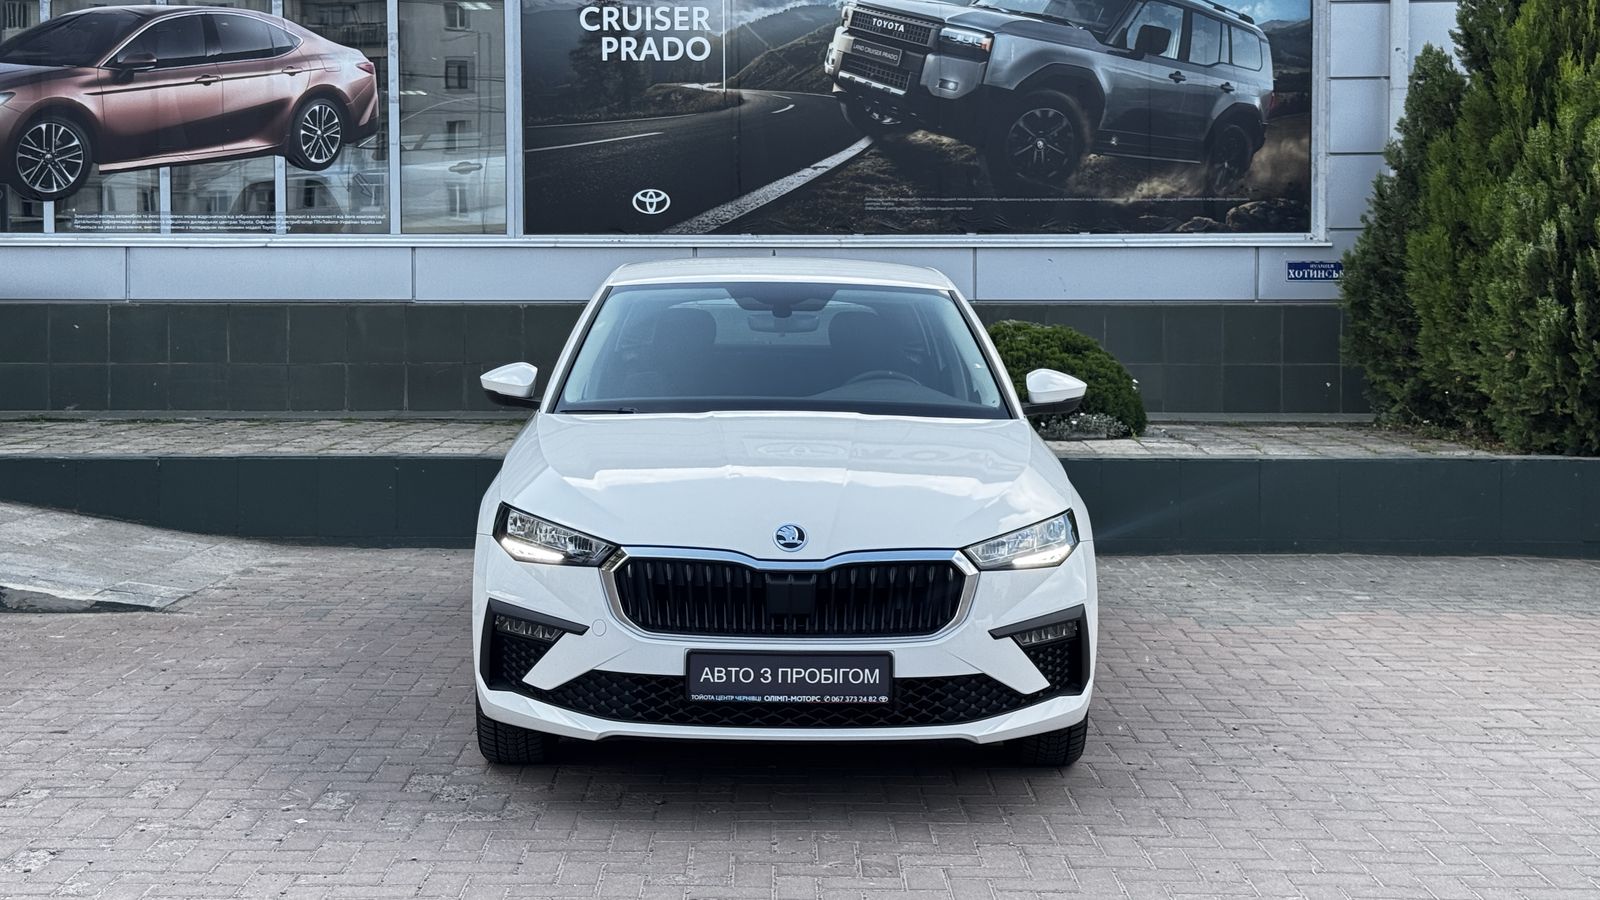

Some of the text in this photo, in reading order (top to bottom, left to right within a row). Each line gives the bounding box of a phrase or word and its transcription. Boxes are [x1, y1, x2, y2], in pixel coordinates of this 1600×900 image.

[579, 6, 711, 31] CRUISER
[872, 18, 905, 33] TOYOTA
[601, 36, 711, 62] PRADO
[882, 51, 898, 61] PRADO
[700, 667, 880, 684] АВТО З ПРОБІГОМ
